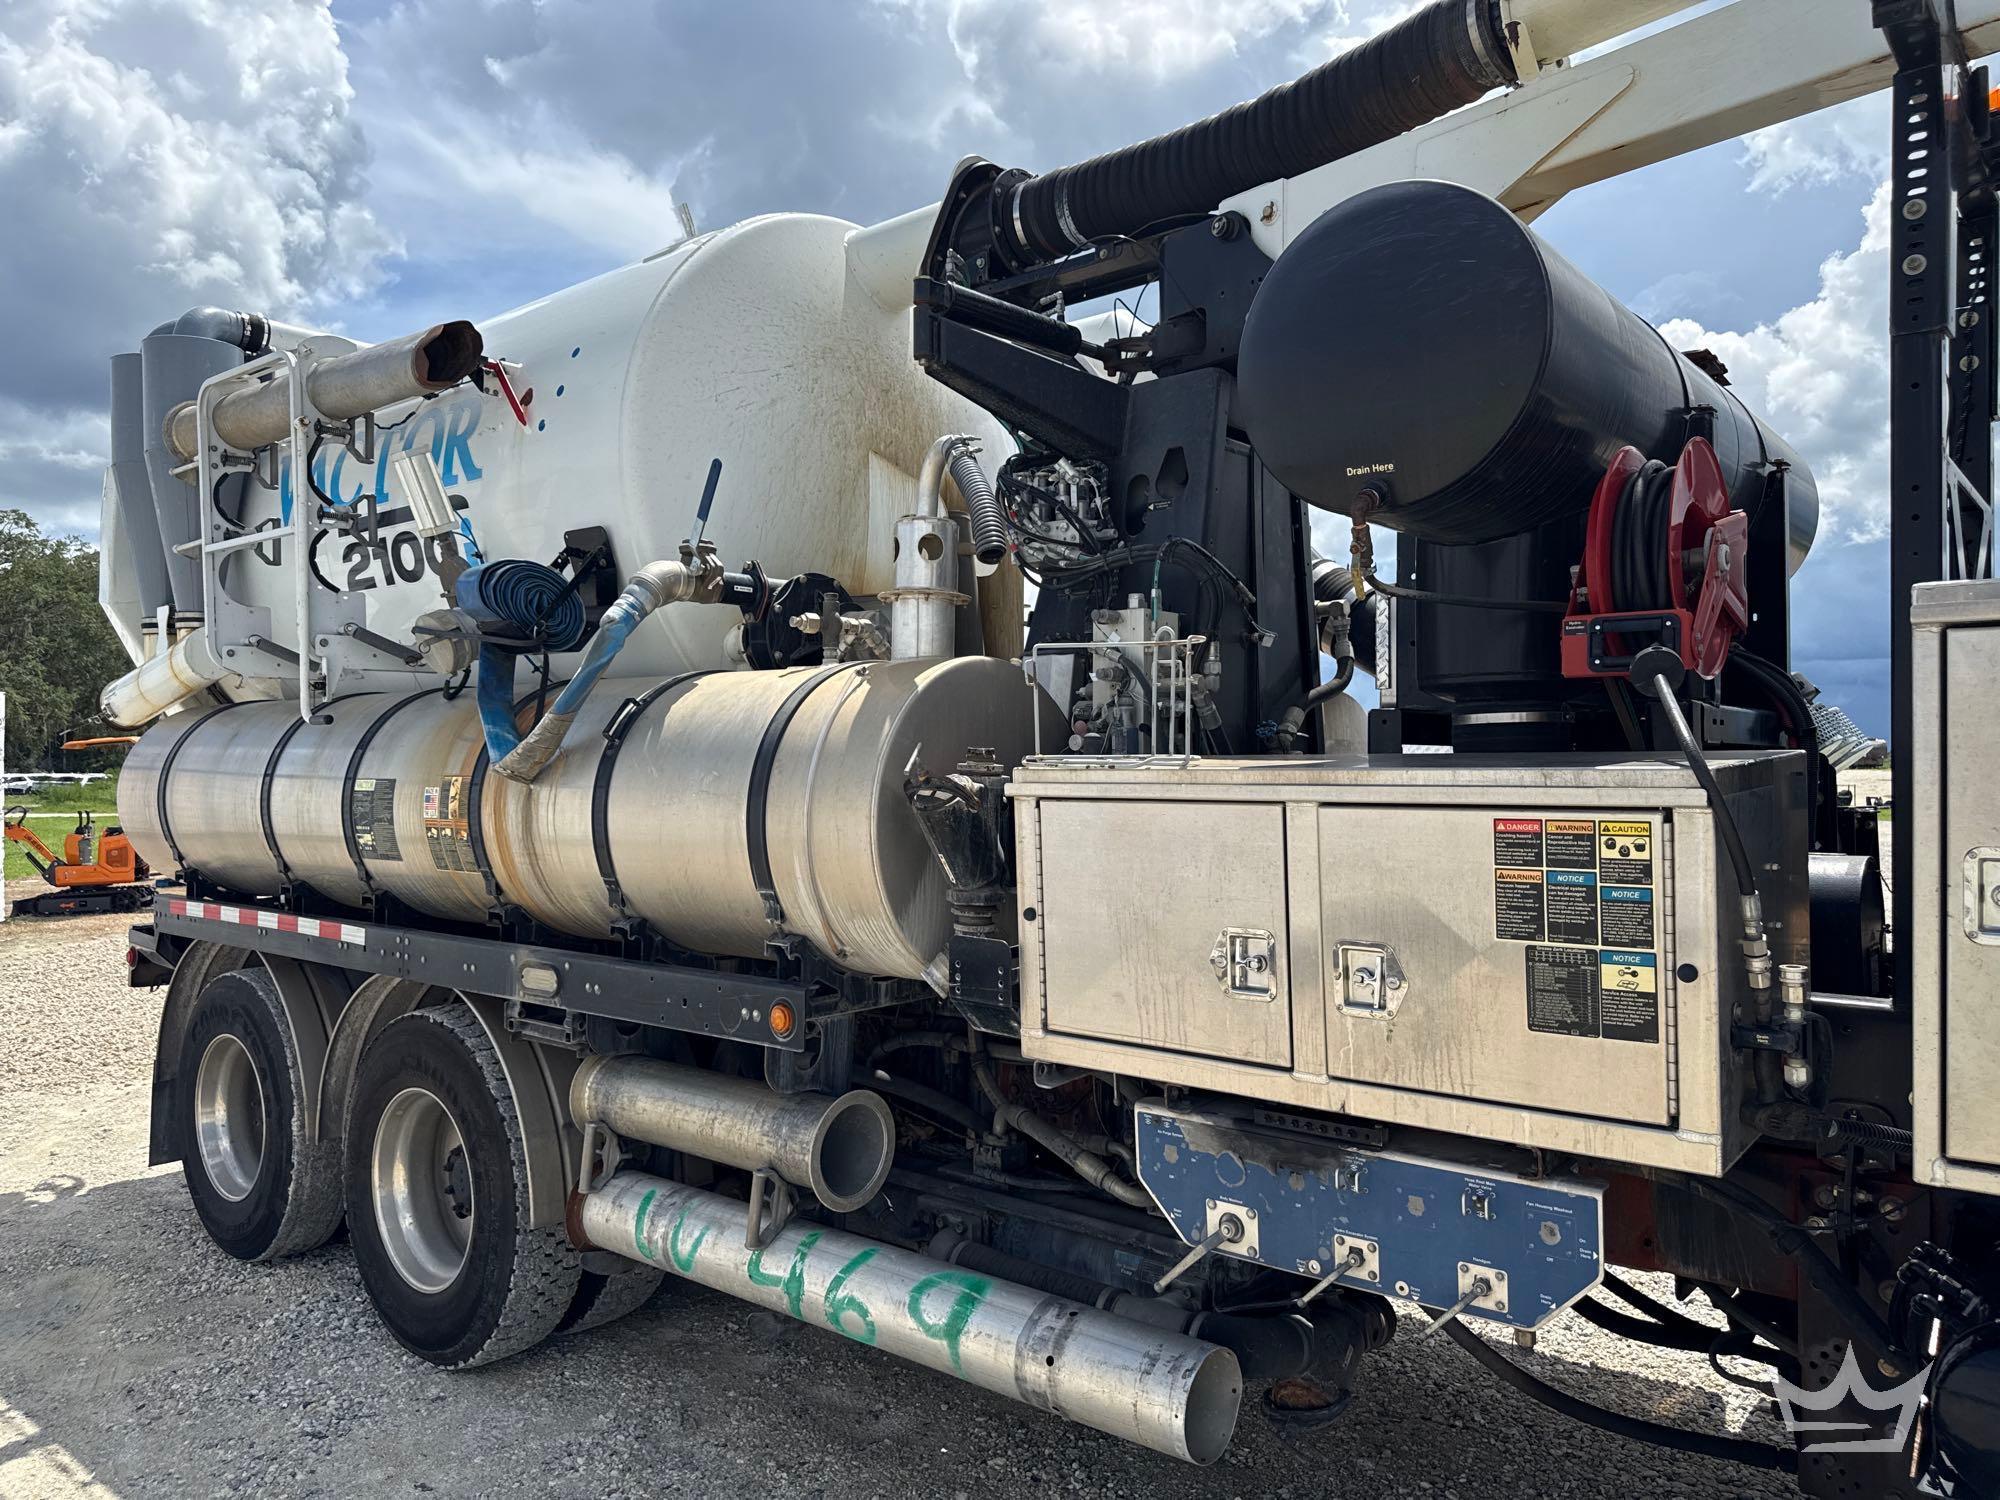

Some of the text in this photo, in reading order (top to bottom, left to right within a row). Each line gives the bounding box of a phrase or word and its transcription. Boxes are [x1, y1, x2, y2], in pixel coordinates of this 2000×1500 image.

[1346, 463, 1394, 476] Drain Here
[1506, 823, 1540, 831] DANGER
[1555, 824, 1593, 832] WARNING
[1504, 872, 1541, 881] WARNING
[1557, 875, 1584, 883] NOTICE
[1612, 955, 1641, 963] NOTICE
[747, 1231, 992, 1381] 469
